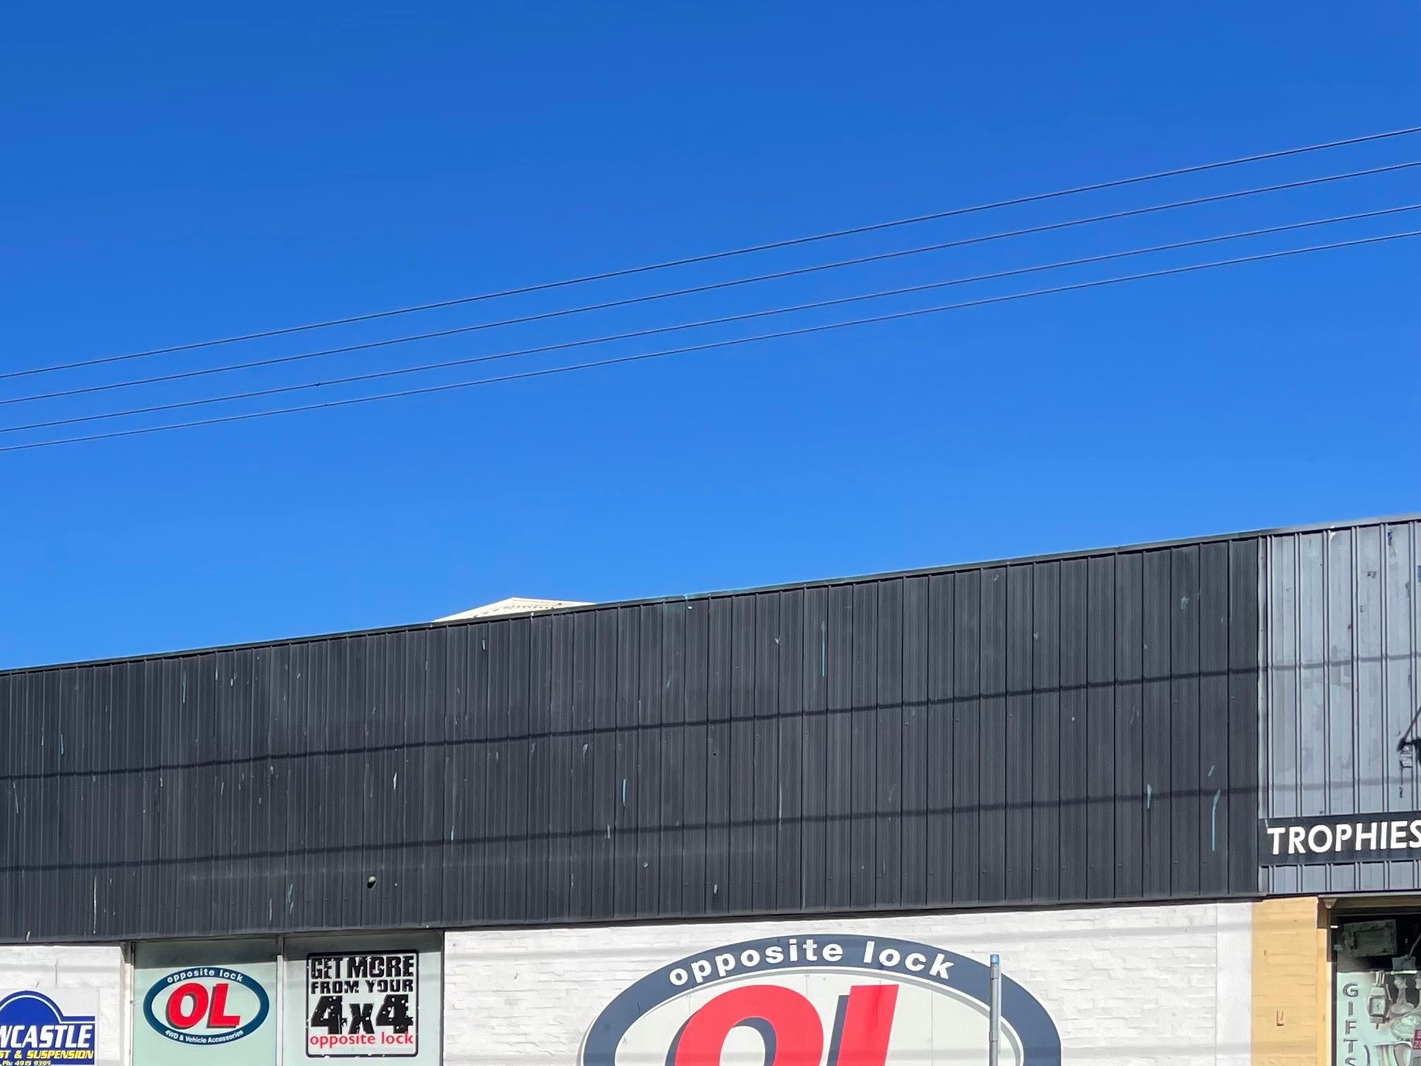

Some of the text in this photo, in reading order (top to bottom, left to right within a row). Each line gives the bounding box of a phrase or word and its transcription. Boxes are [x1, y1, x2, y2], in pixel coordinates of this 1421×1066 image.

[1267, 819, 1421, 856] TROPHIES
[310, 955, 414, 980] GET MORE
[669, 938, 955, 986] opposite lock
[166, 967, 244, 984] opposite lock
[310, 978, 414, 995] FROM YOUR
[165, 982, 241, 1030] OL
[310, 993, 414, 1035] 4x4
[164, 1030, 179, 1040] 4WD
[185, 1035, 207, 1044] Vehicle
[207, 1029, 244, 1044] Accessories
[309, 1029, 414, 1049] opposite lock
[14, 1050, 22, 1059] &
[26, 1049, 94, 1060] SUSPENSION
